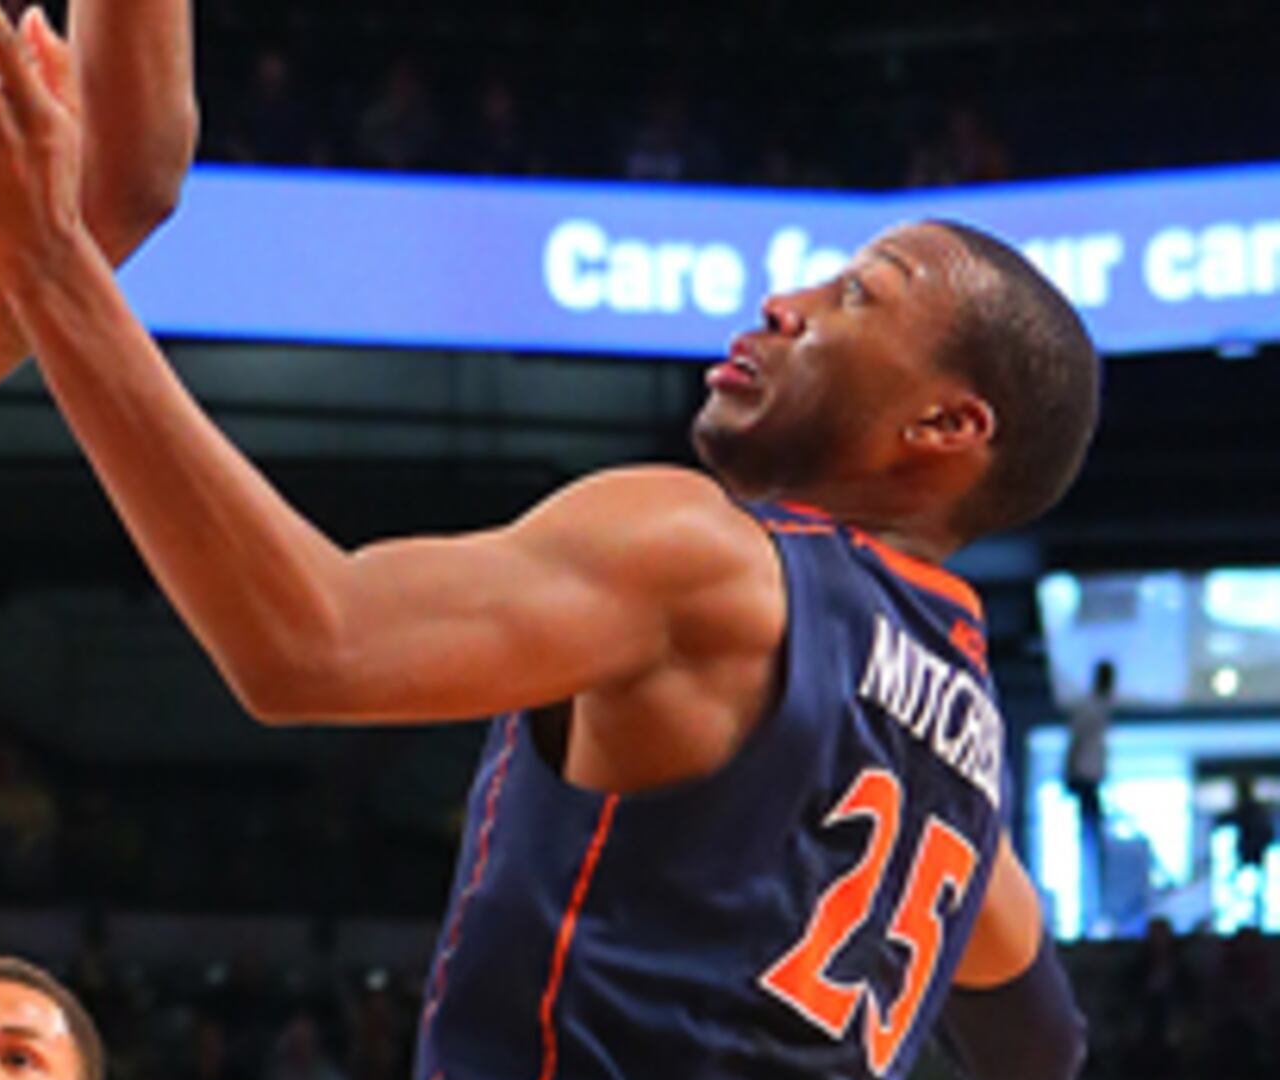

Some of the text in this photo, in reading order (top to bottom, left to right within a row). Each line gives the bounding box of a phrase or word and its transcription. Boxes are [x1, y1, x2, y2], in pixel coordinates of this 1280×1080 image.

[543, 219, 745, 316] Care
[766, 226, 854, 298] fo
[758, 768, 980, 1079] 25
